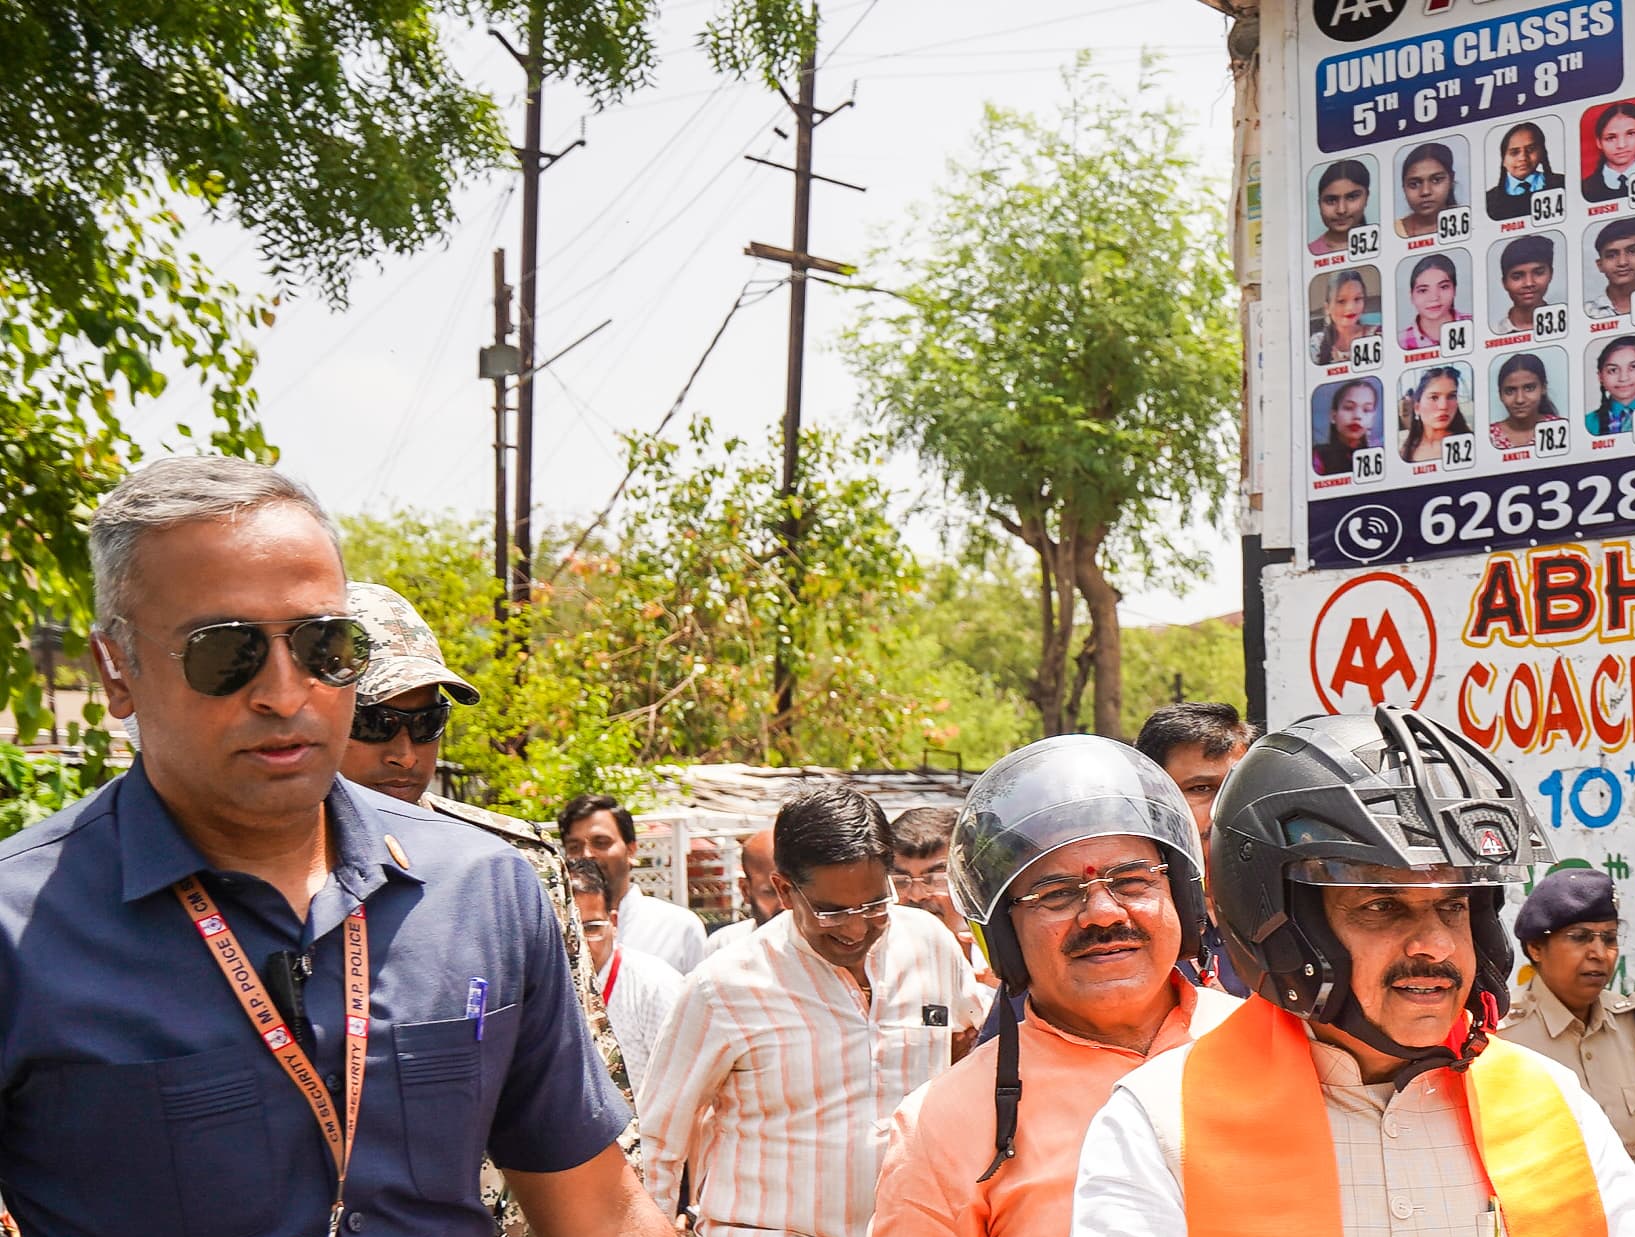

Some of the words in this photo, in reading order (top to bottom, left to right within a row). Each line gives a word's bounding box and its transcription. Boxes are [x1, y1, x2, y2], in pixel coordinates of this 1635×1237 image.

[1323, 39, 1445, 97] JUNIOR
[1453, 4, 1616, 66] CLASSES
[1533, 194, 1564, 221] 93.4
[1439, 212, 1470, 239] 93.6
[1350, 230, 1378, 256] 95.2
[1536, 309, 1566, 336] 83.8
[1449, 327, 1465, 351] 84
[1353, 341, 1381, 367] 84.6
[1538, 426, 1567, 451] 78.2
[1591, 438, 1616, 450] DOLLY
[1356, 452, 1383, 478] 78.6
[1445, 439, 1472, 465] 78.2
[349, 922, 362, 978] POLICE
[215, 937, 256, 993] POLICE
[284, 1053, 333, 1120] SECURITY
